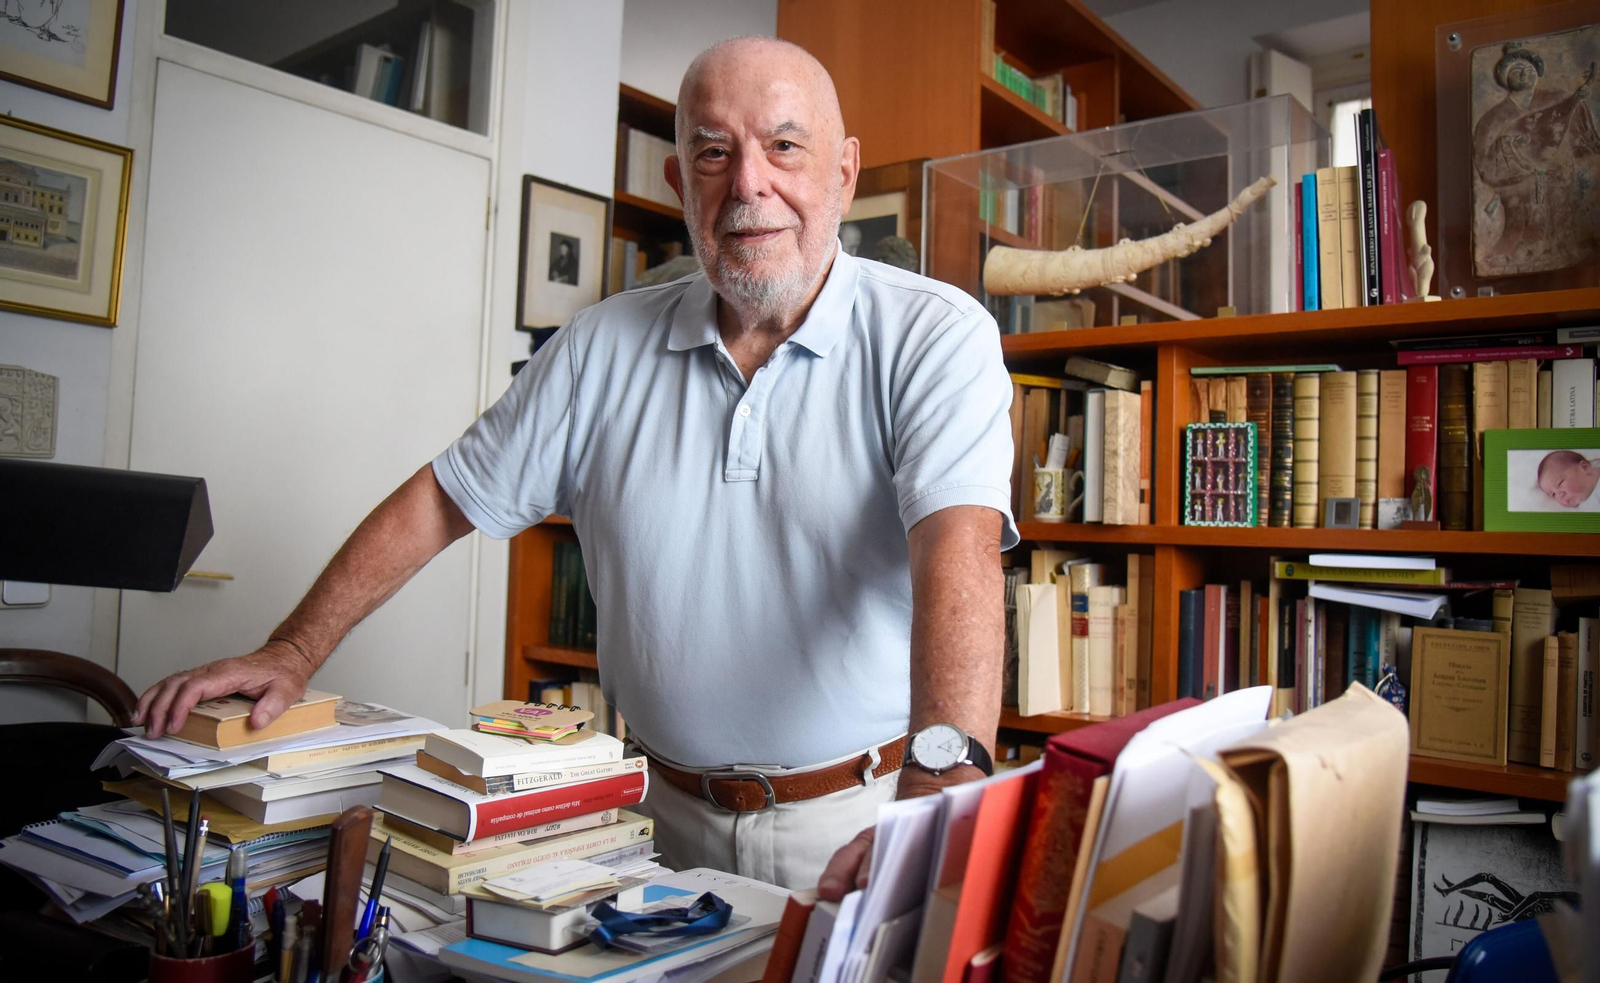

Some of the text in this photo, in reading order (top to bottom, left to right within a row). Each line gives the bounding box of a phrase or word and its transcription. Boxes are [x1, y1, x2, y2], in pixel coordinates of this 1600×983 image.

[1325, 569, 1372, 577] CLASSICAL
[1376, 571, 1415, 579] STUDIES
[517, 772, 562, 785] FITZGERALD
[524, 808, 541, 818] animal
[560, 844, 584, 856] ESPAÑOLA
[585, 841, 601, 850] CORTE
[507, 858, 532, 869] ITALIANO
